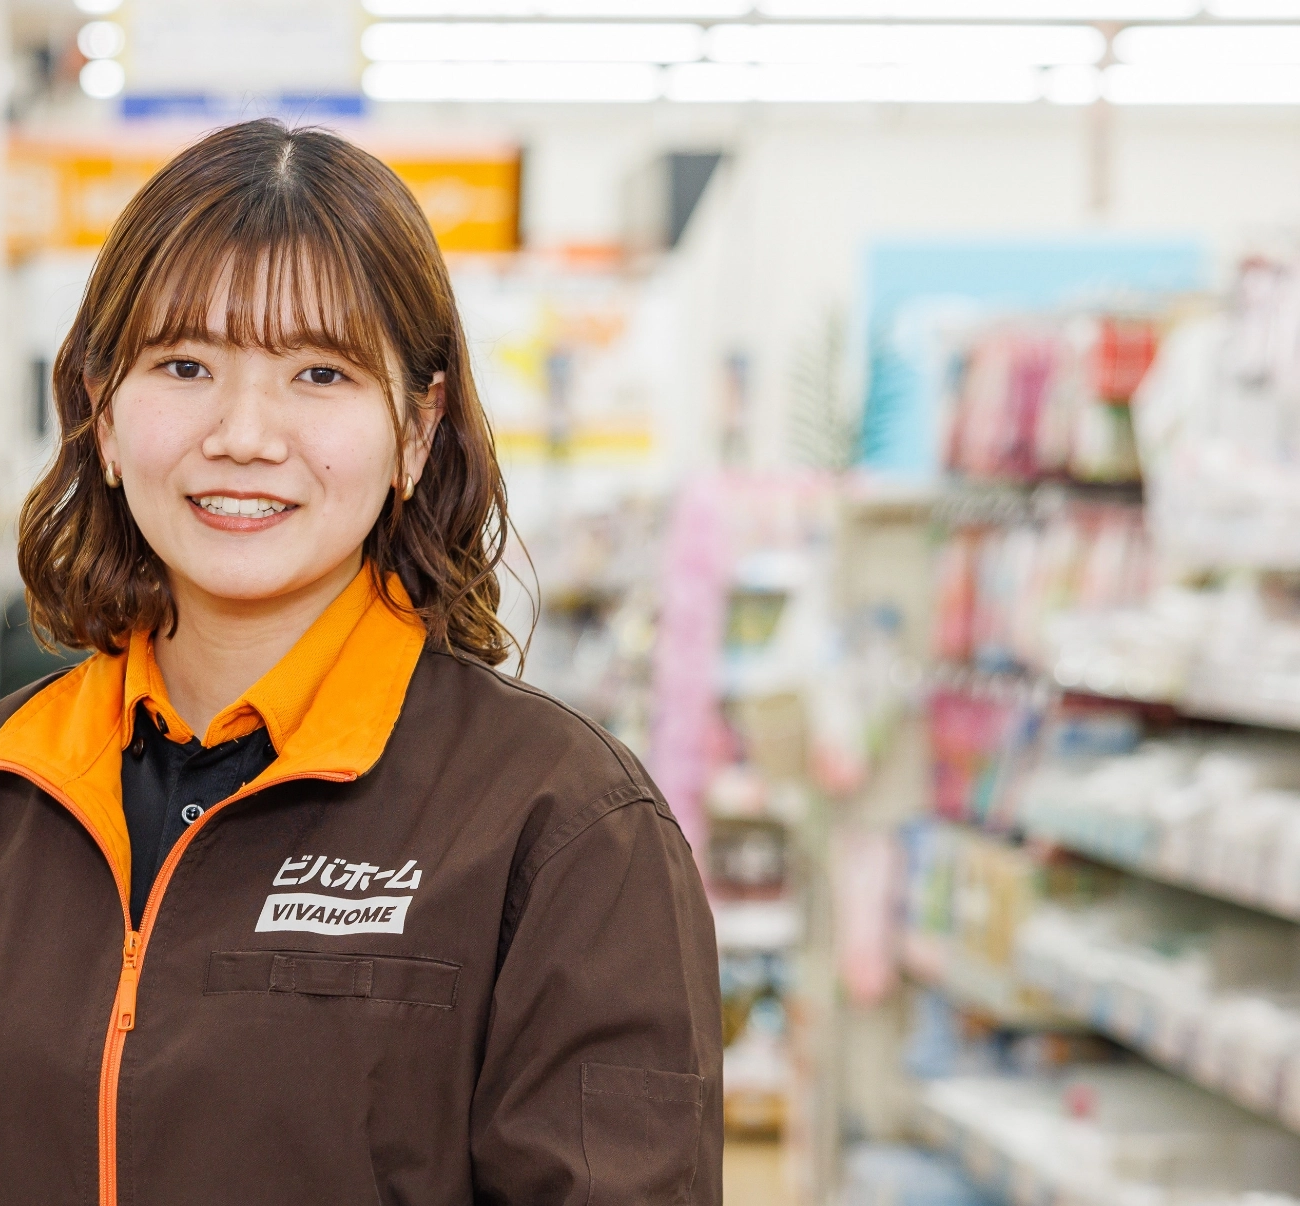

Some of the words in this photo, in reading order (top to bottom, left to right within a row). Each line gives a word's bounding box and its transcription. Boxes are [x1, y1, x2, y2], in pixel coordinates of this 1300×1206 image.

[272, 855, 423, 891] ビバホーム
[272, 903, 398, 926] VIVAHOME
